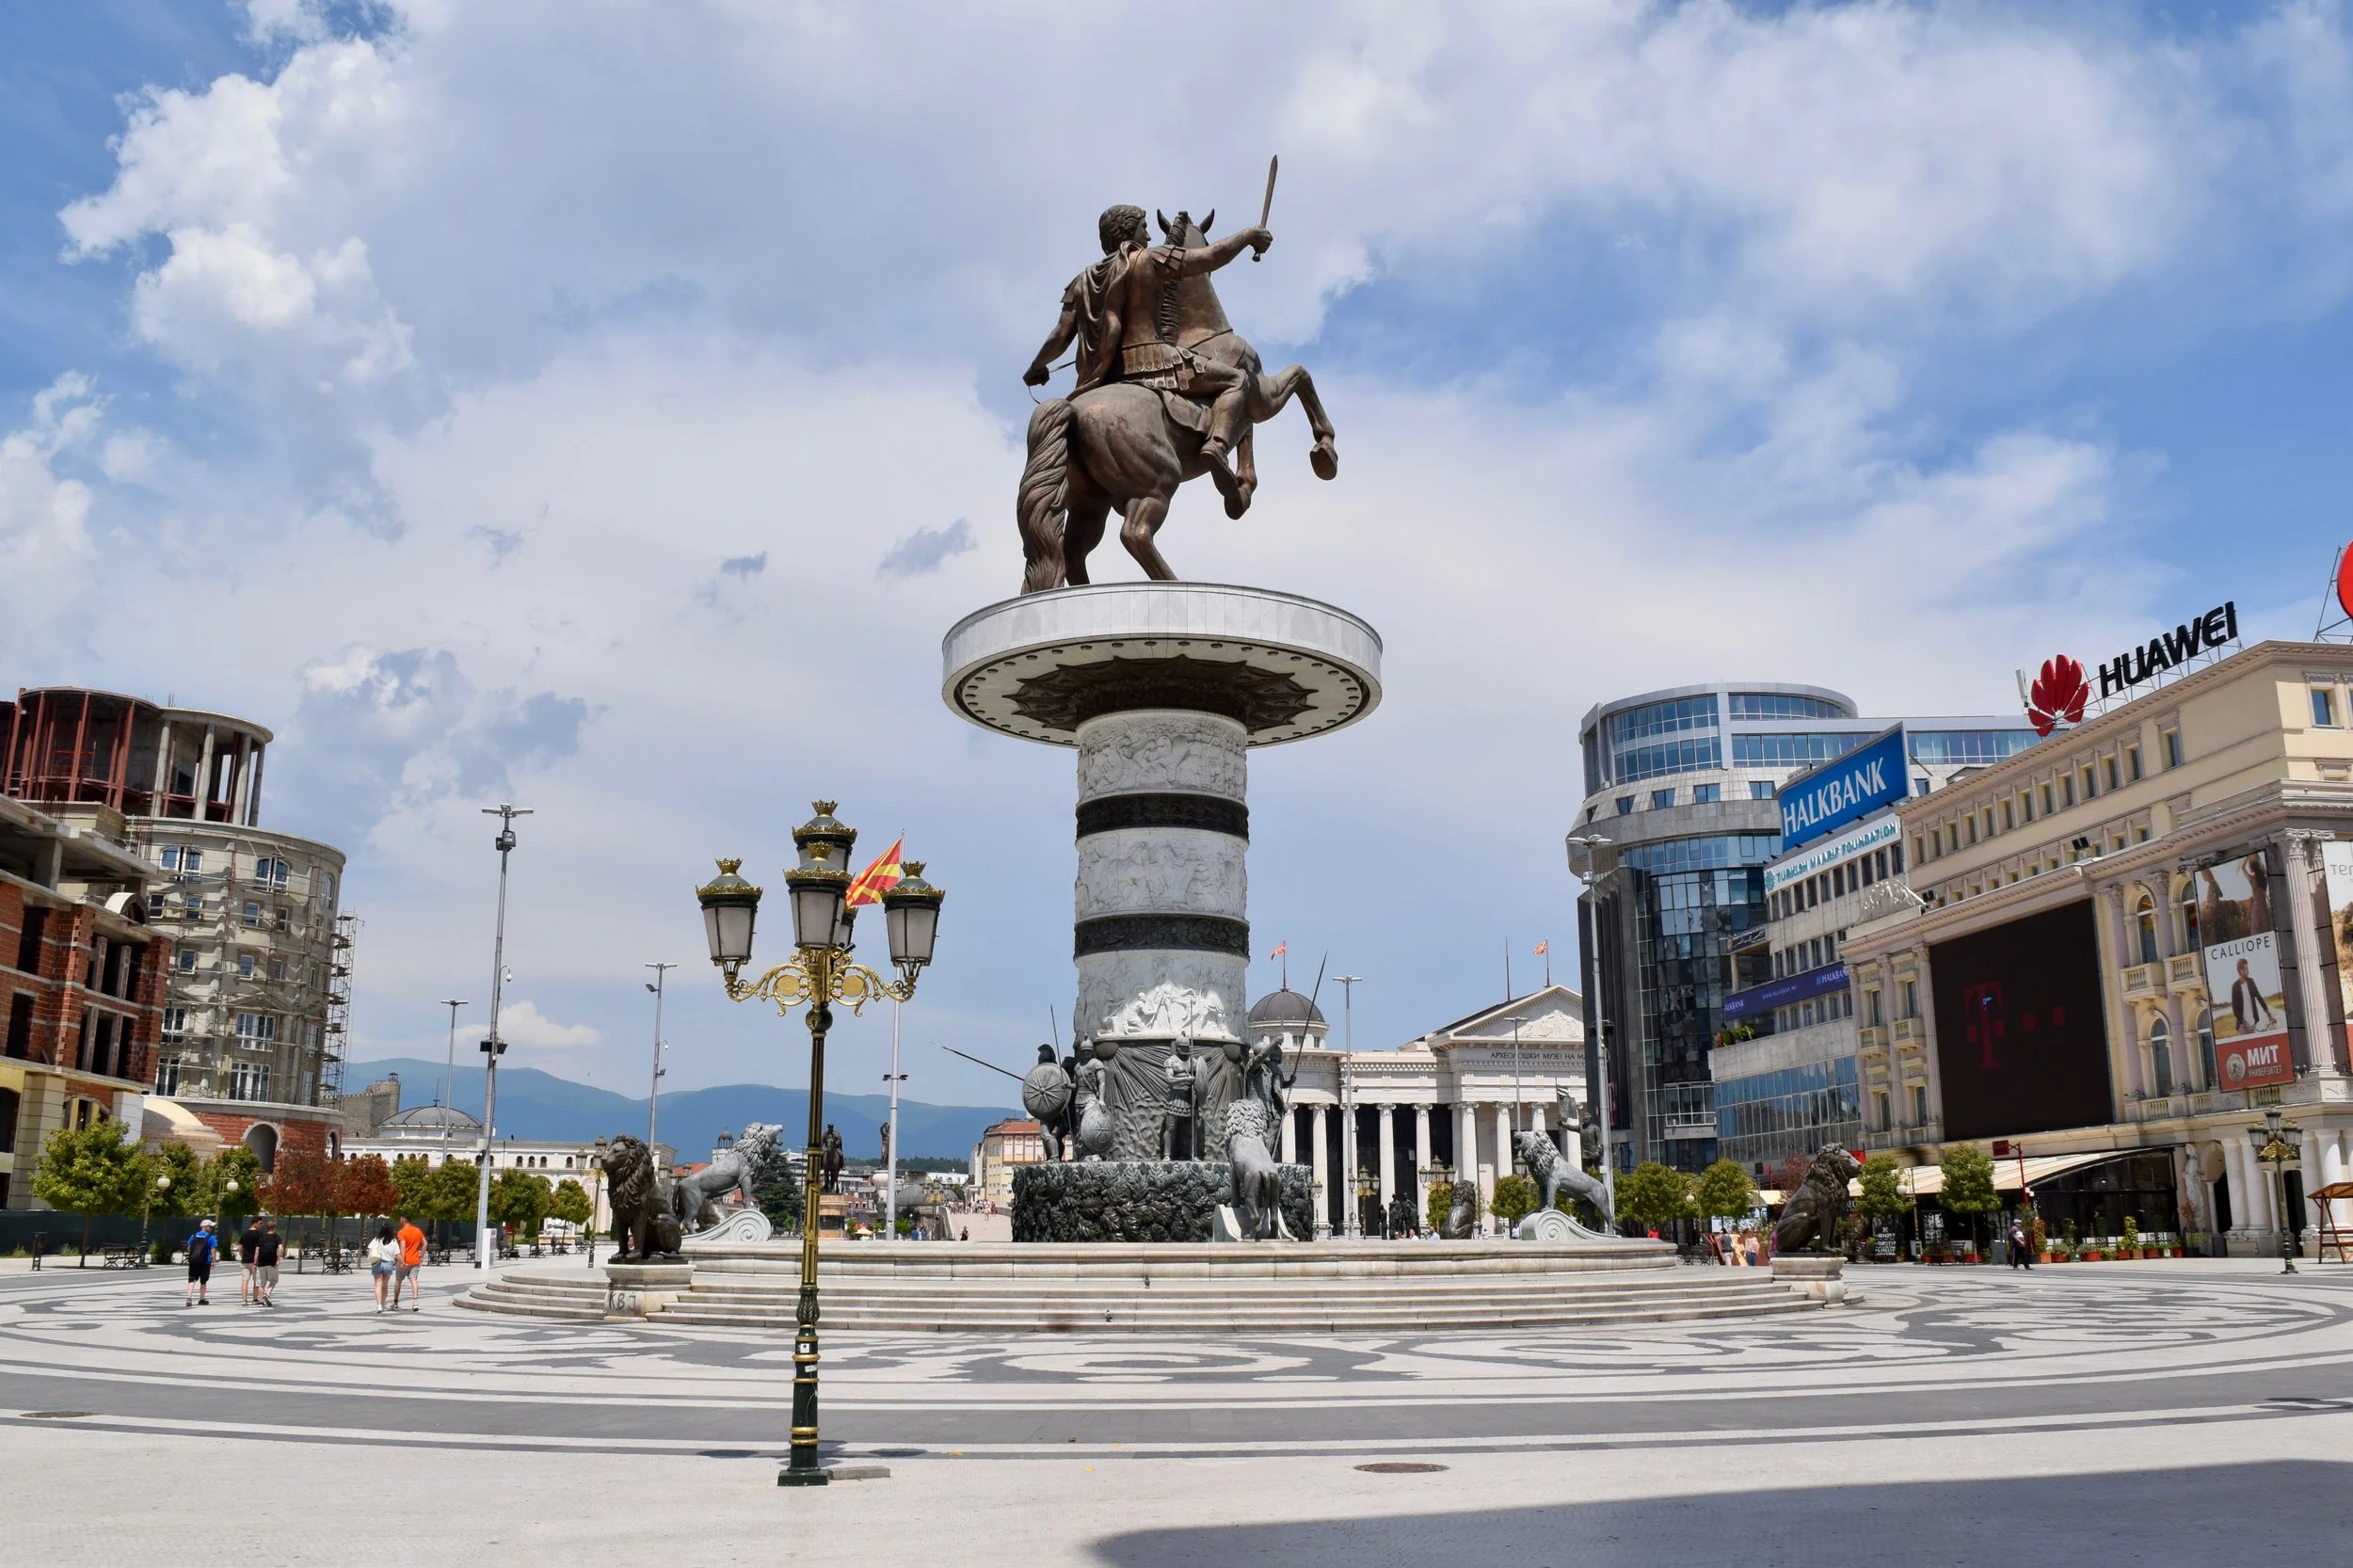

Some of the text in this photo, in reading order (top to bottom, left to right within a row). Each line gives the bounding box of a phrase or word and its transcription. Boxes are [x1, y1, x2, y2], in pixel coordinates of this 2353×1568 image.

[2099, 600, 2237, 698] HUAWEI
[1783, 757, 1887, 838] HALKBANK
[1776, 822, 1897, 883] TURKISH MAARIF FOUNDATION
[2211, 936, 2270, 961] CALLIOPE
[1821, 969, 1849, 984] HALKBAN
[2247, 1045, 2279, 1067] МИТ
